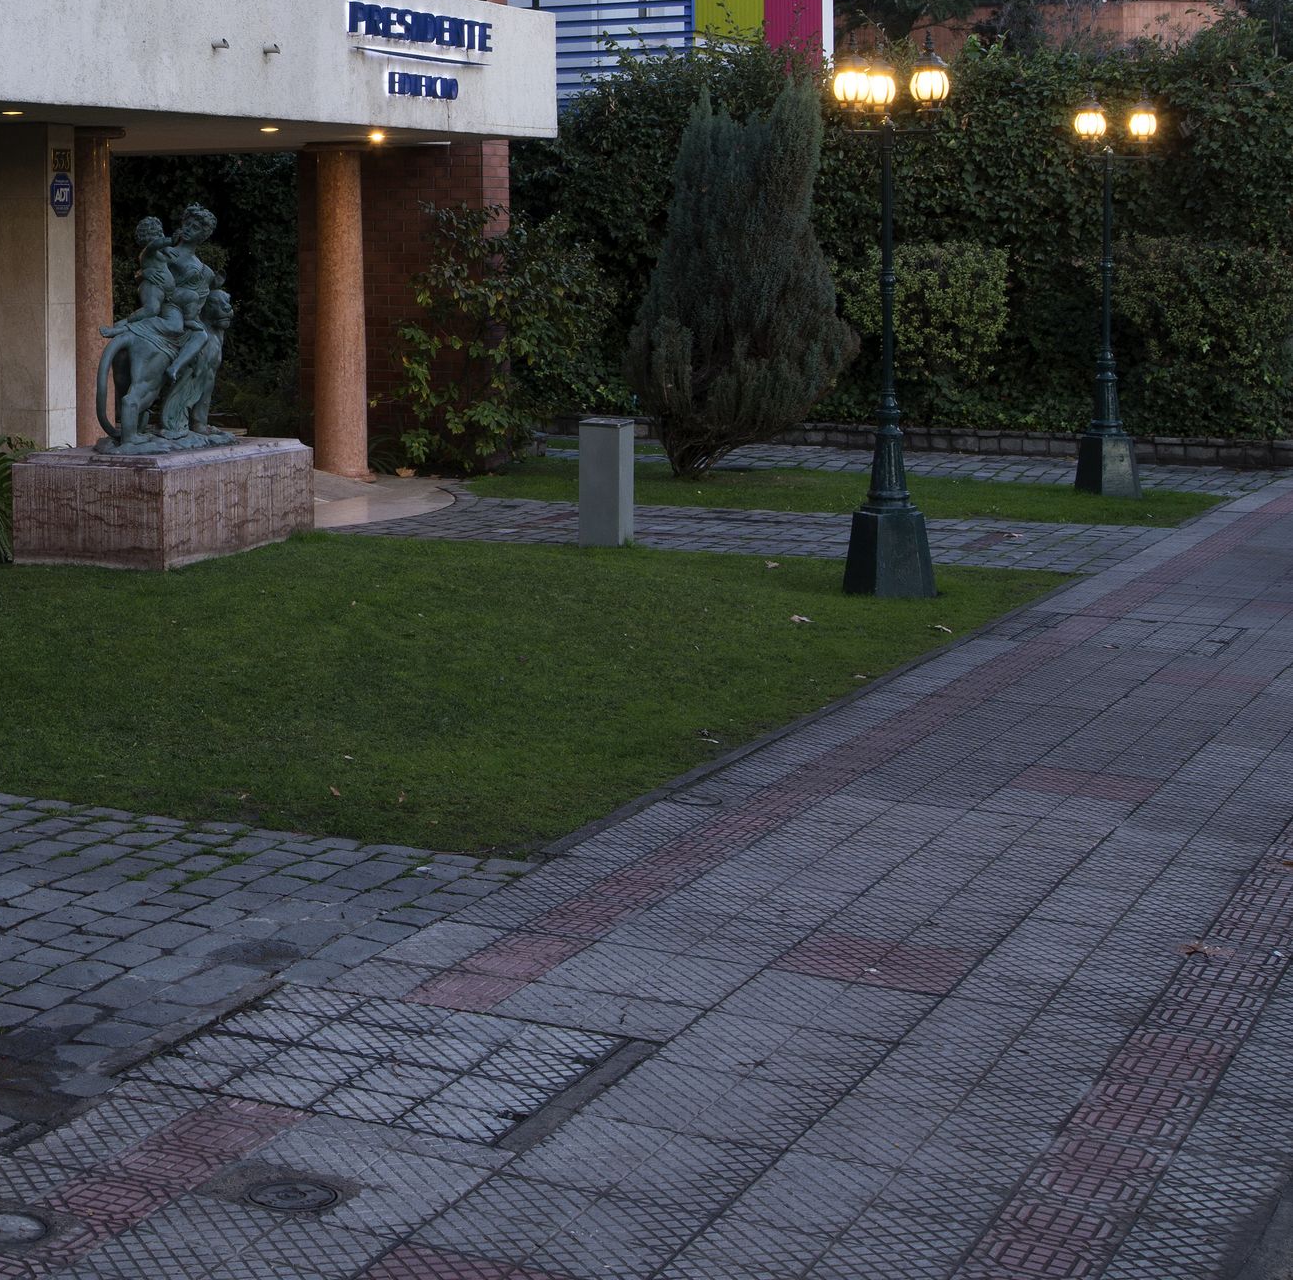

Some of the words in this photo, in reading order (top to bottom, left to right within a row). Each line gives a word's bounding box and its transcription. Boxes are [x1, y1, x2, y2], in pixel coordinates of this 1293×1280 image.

[348, 1, 493, 53] PRESIDENTE
[388, 71, 459, 101] EDIFICIO
[54, 187, 70, 203] ADT
